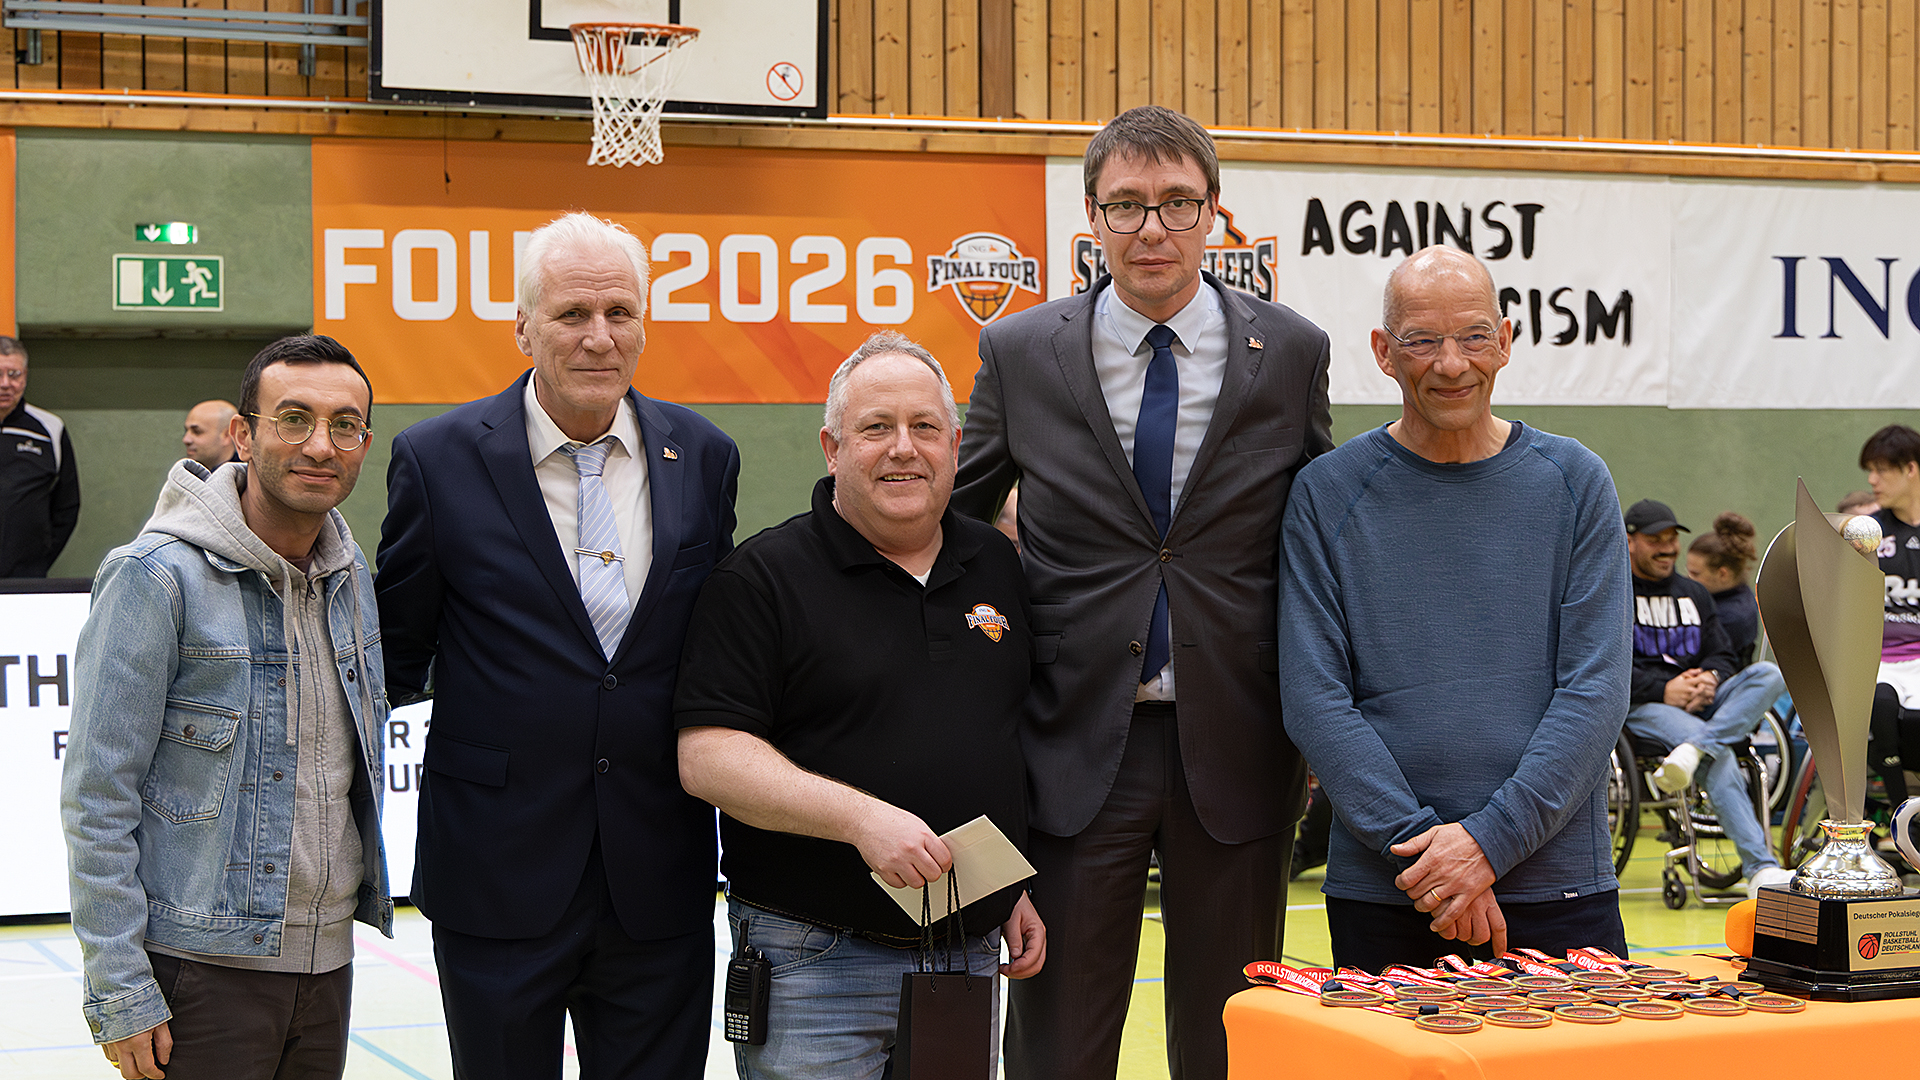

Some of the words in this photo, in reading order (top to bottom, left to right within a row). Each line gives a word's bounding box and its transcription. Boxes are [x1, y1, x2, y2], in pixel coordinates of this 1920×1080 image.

[1301, 197, 1545, 260] AGAINST
[324, 229, 531, 320] FOU
[651, 233, 914, 324] 2026
[931, 259, 985, 287] FINAL
[989, 260, 1037, 289] FOUR
[1500, 287, 1633, 347] CISM
[1772, 256, 1920, 340] IN
[1853, 912, 1887, 920] Deutscher
[1888, 910, 1920, 919] Pokalsieg
[1881, 944, 1920, 952] DEUTSCHLAN
[1883, 937, 1919, 945] BASKETBALL
